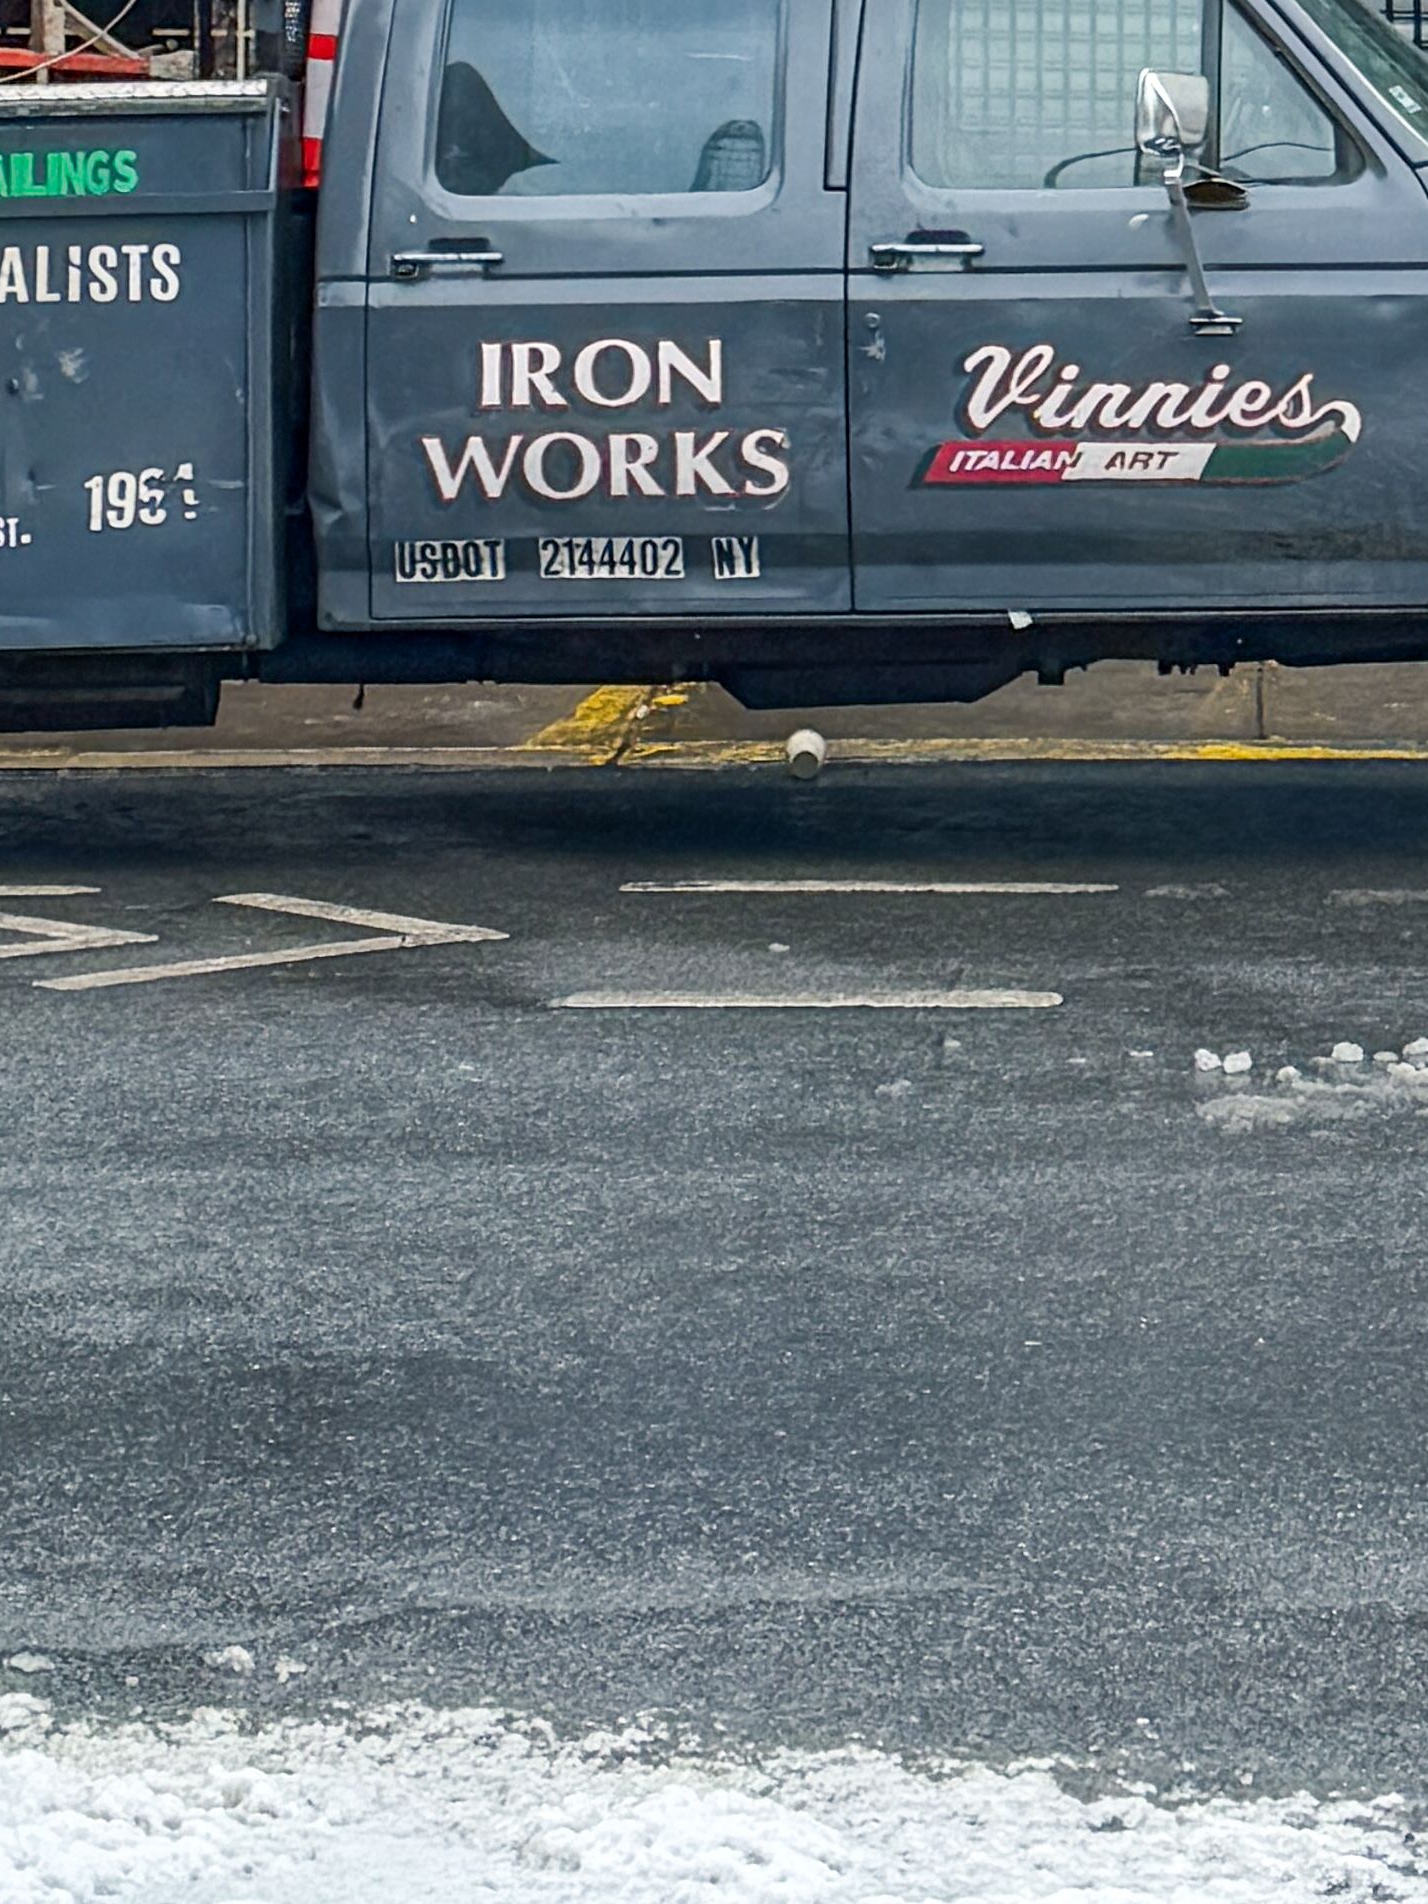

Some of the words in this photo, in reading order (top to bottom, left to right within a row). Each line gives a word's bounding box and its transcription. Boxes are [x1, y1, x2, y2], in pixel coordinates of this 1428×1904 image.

[480, 338, 722, 407] IRON
[964, 344, 1360, 442] Vinnies
[421, 428, 790, 500] WORKS
[949, 449, 1083, 472] ITALIAN
[1105, 451, 1179, 471] ART
[397, 541, 502, 580] USDOT
[542, 538, 683, 577] 2144402
[714, 537, 758, 576] NY
